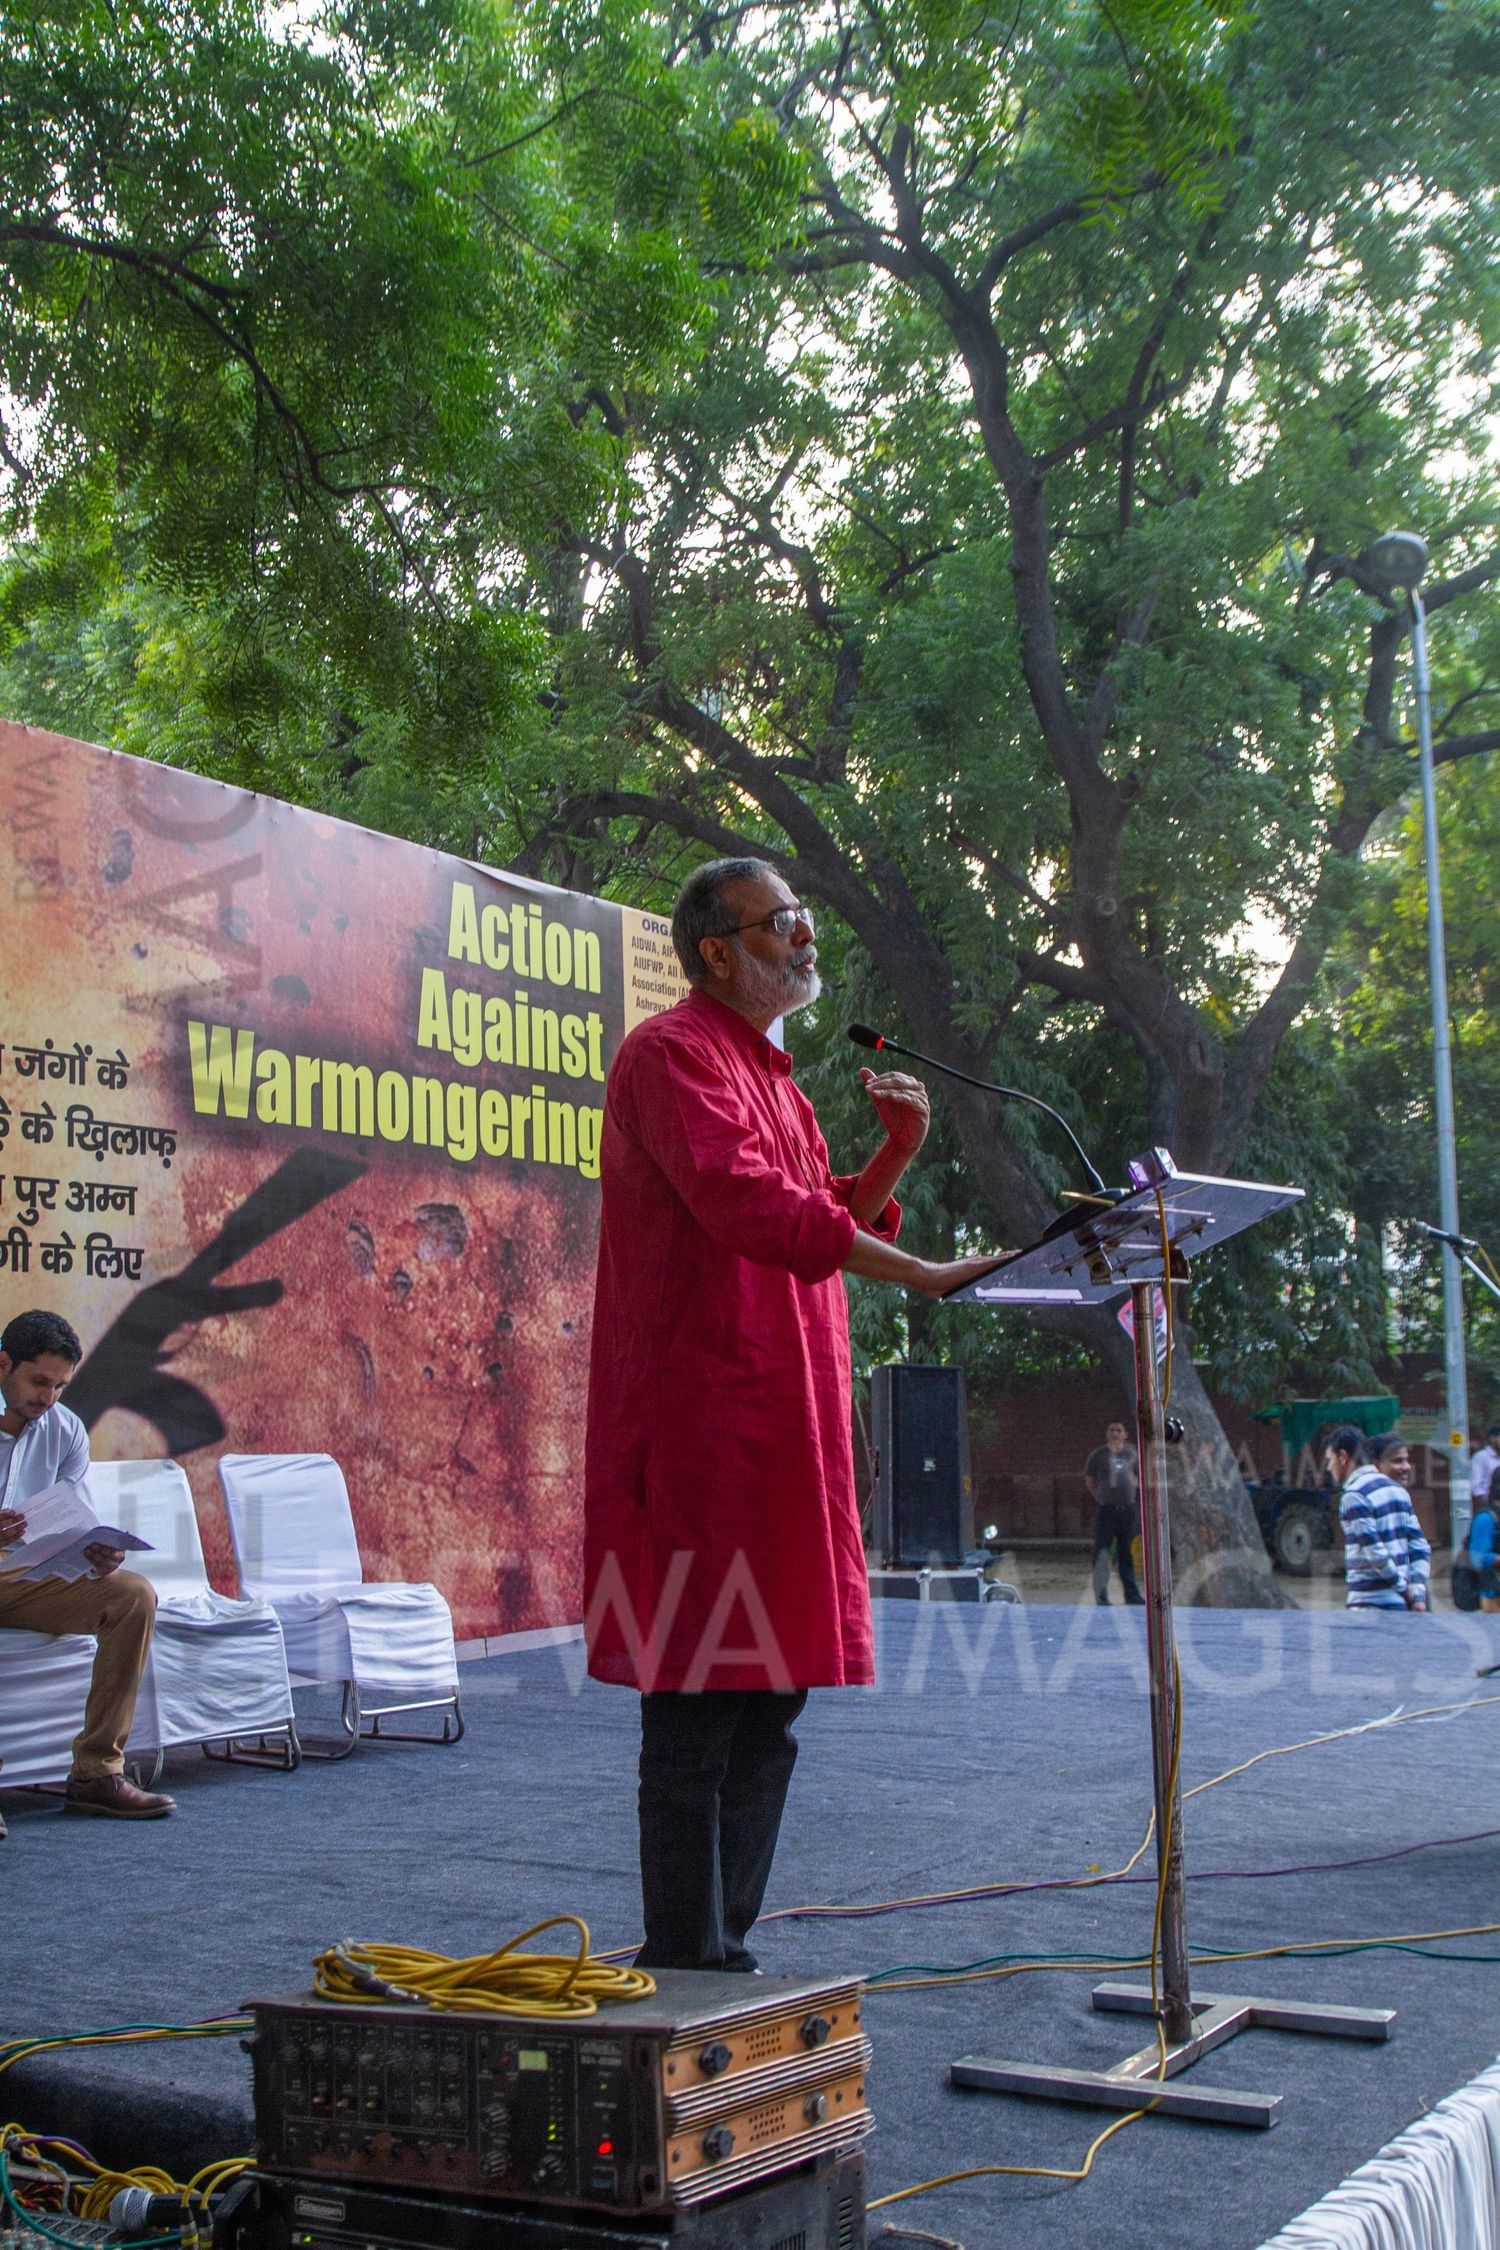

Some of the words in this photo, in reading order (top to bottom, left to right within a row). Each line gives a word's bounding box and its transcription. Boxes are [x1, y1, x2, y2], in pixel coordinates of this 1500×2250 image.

[447, 880, 602, 995] Action
[641, 918, 673, 937] ORG
[661, 943, 678, 960] AIP
[631, 974, 677, 998] Association
[417, 966, 605, 1083] Against
[12, 1038, 93, 1086] जंगों
[96, 1048, 131, 1090] के
[20, 1100, 57, 1144] के
[187, 1019, 604, 1180] Warmongering
[14, 1175, 60, 1227] पुर
[64, 1180, 138, 1216] अम्न
[40, 1230, 76, 1275] के
[84, 1232, 145, 1281] लिए
